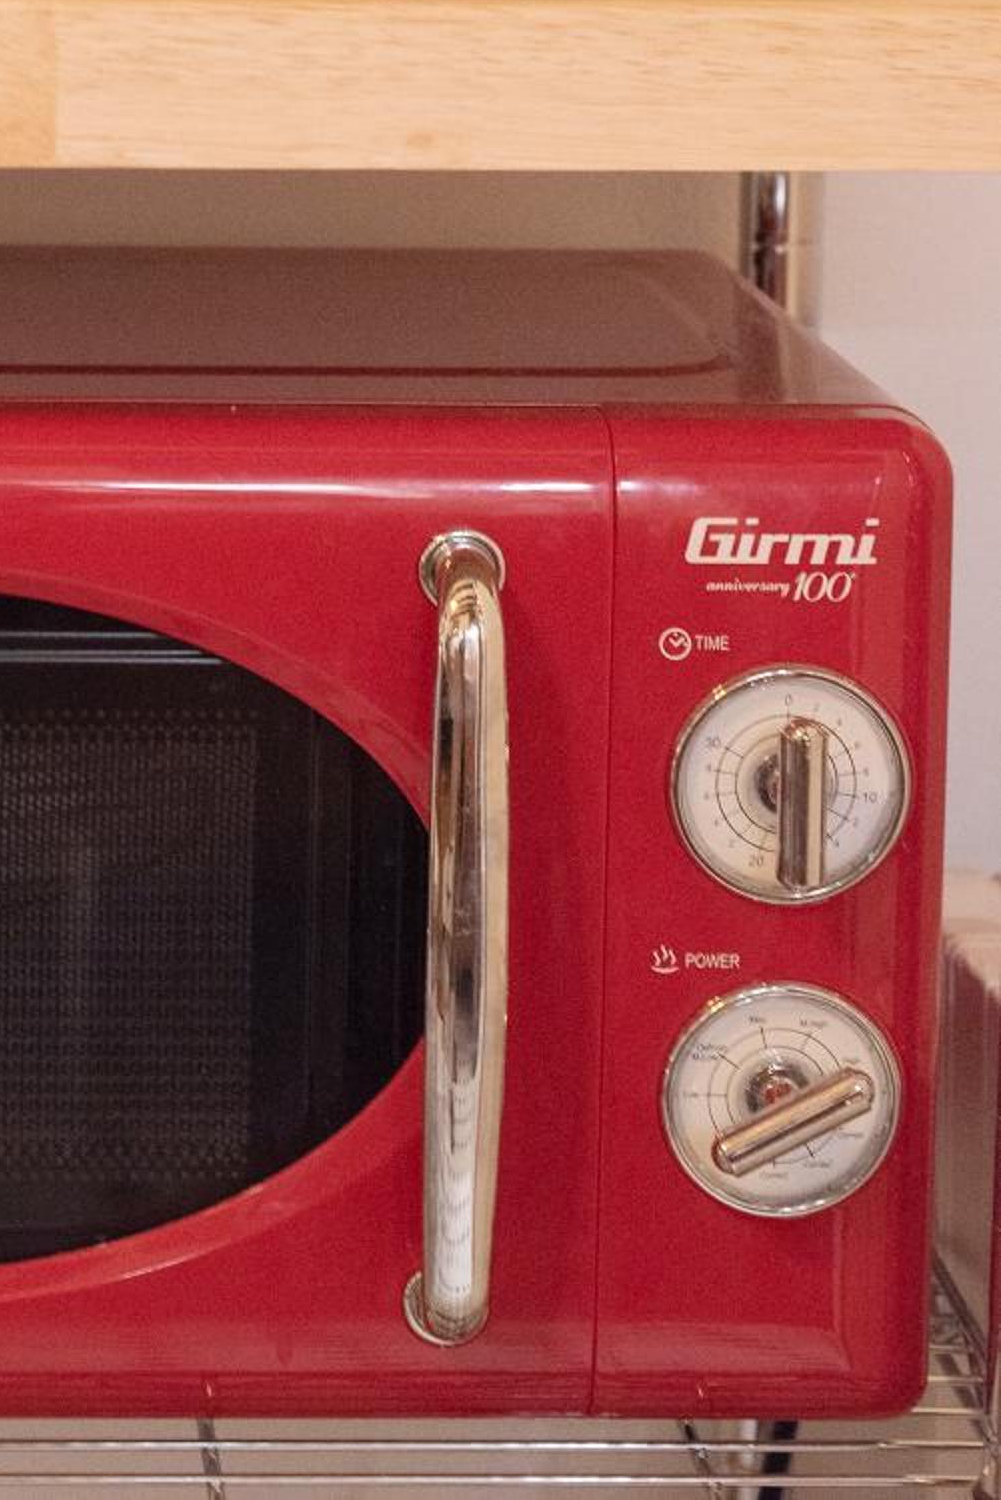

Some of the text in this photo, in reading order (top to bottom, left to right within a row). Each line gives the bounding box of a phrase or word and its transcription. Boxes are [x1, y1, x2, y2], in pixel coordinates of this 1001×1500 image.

[685, 517, 879, 564] Girmi
[706, 578, 790, 598] anniversary
[695, 635, 730, 651] TIME
[862, 790, 879, 803] 10
[685, 953, 741, 969] POWER
